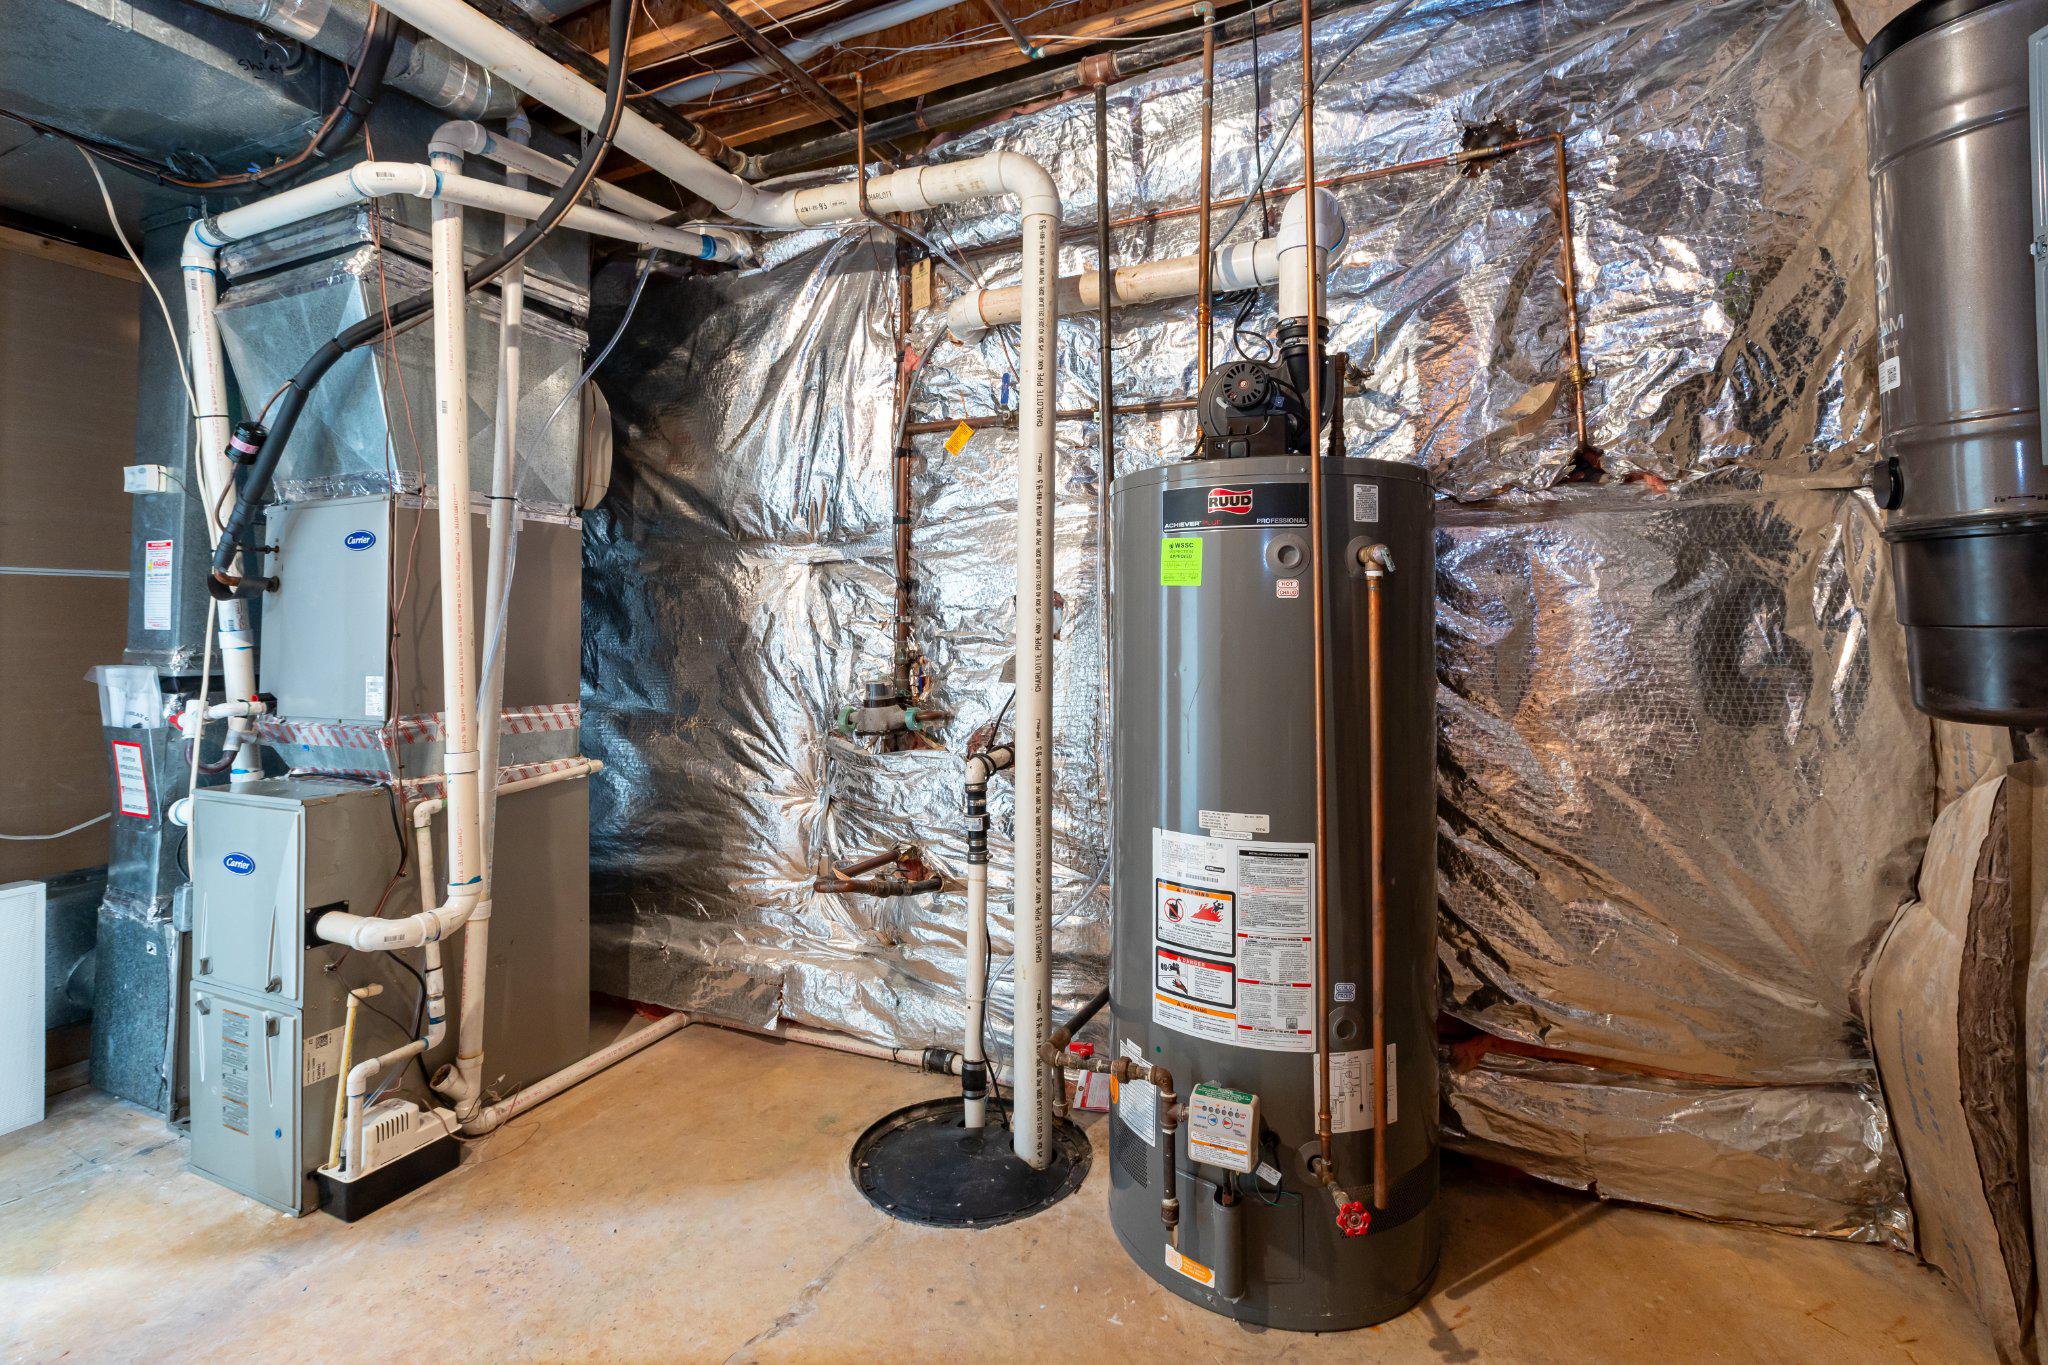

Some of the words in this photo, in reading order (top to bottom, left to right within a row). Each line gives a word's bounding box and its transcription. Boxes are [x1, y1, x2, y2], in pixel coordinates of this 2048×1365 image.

[1036, 373, 1045, 387] PIPE
[1036, 390, 1044, 427] CHARLOTTE
[1208, 495, 1252, 508] RUUD
[1164, 521, 1200, 529] ACHIEVER
[347, 535, 371, 545] Carrier
[1035, 636, 1043, 651] PIPE
[226, 857, 251, 869] Carrier
[1182, 889, 1210, 898] WARNING
[1035, 923, 1043, 963] CHARLOTTE
[1182, 957, 1206, 968] DANGER
[1183, 1002, 1208, 1014] WARNING
